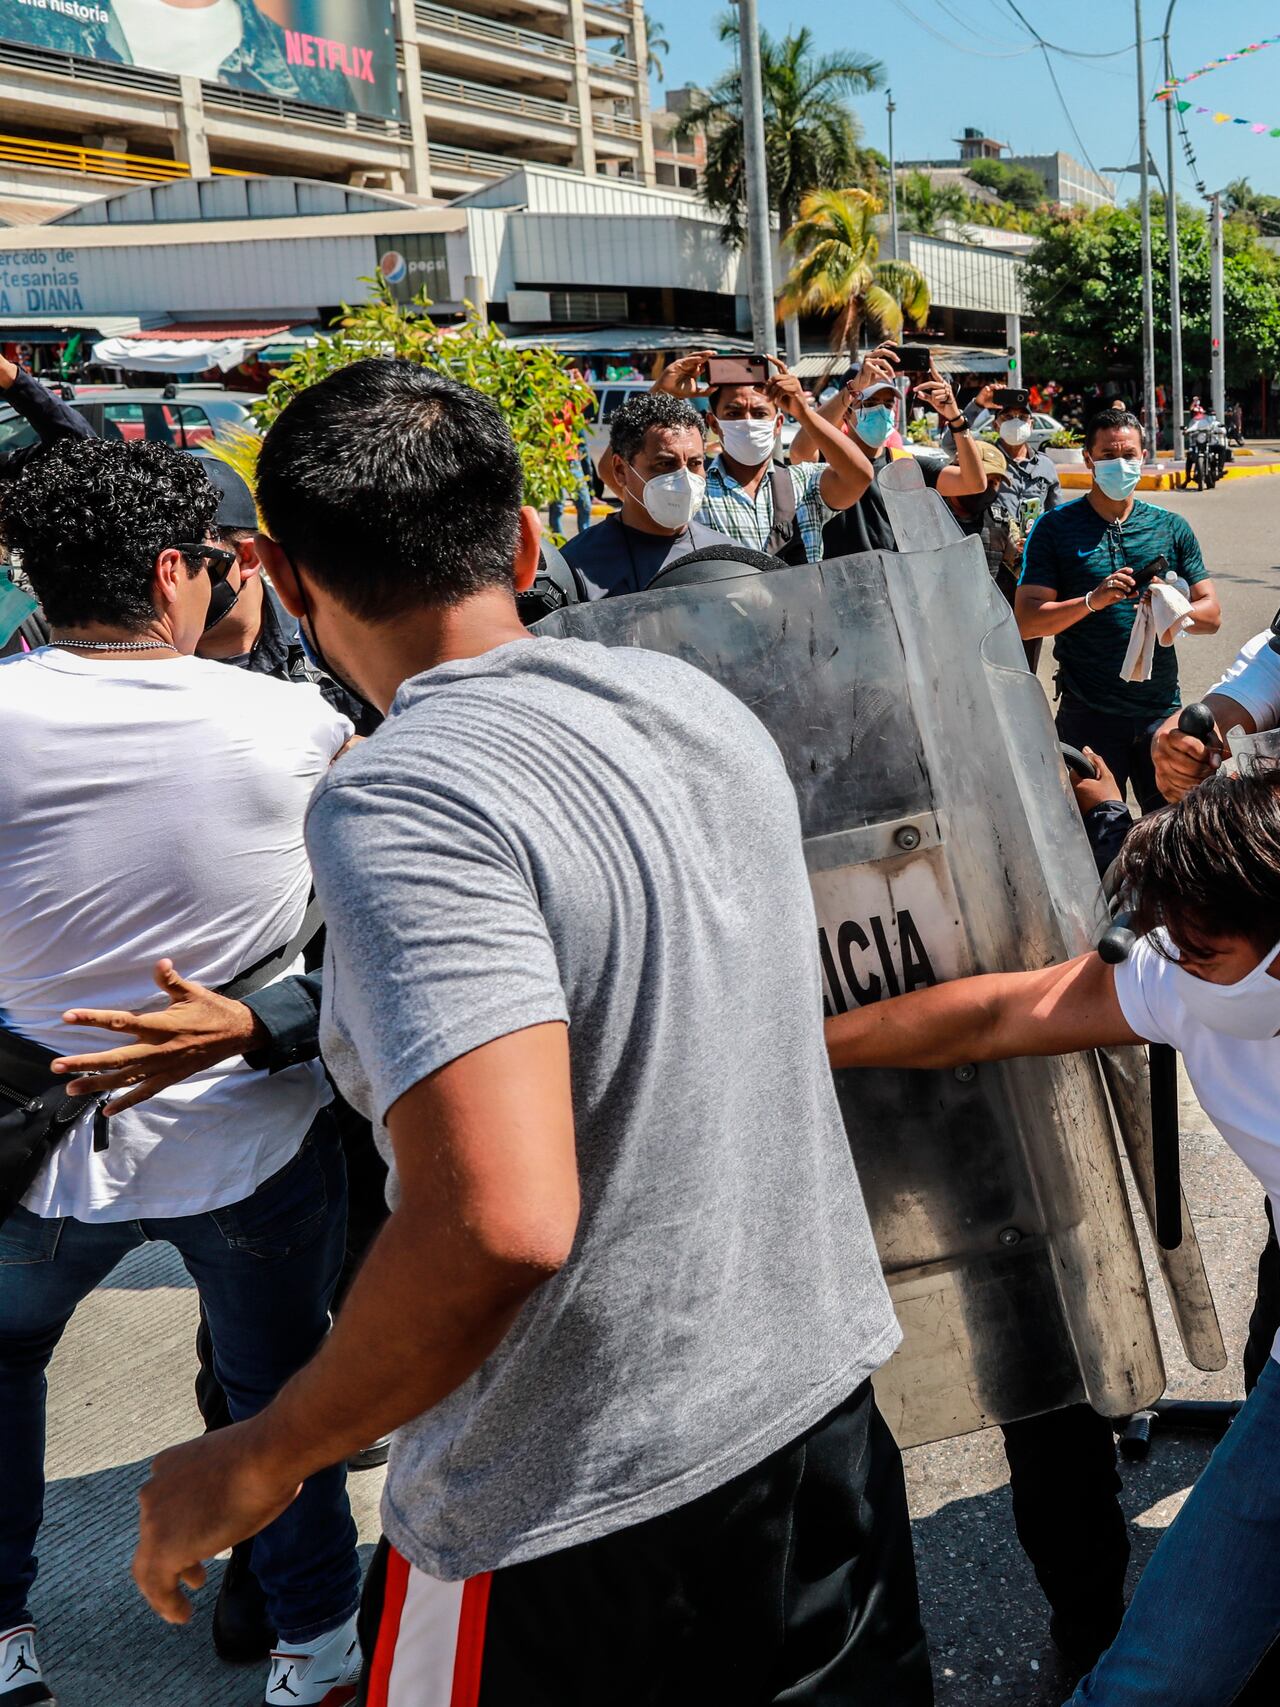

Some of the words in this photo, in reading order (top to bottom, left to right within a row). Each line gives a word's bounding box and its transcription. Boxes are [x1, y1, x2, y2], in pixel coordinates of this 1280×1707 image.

[49, 0, 109, 23] historia
[285, 29, 375, 84] NETFLIX
[56, 249, 75, 263] de
[408, 256, 446, 275] pepsi
[0, 267, 79, 288] tesanias
[26, 288, 84, 311] DIANA
